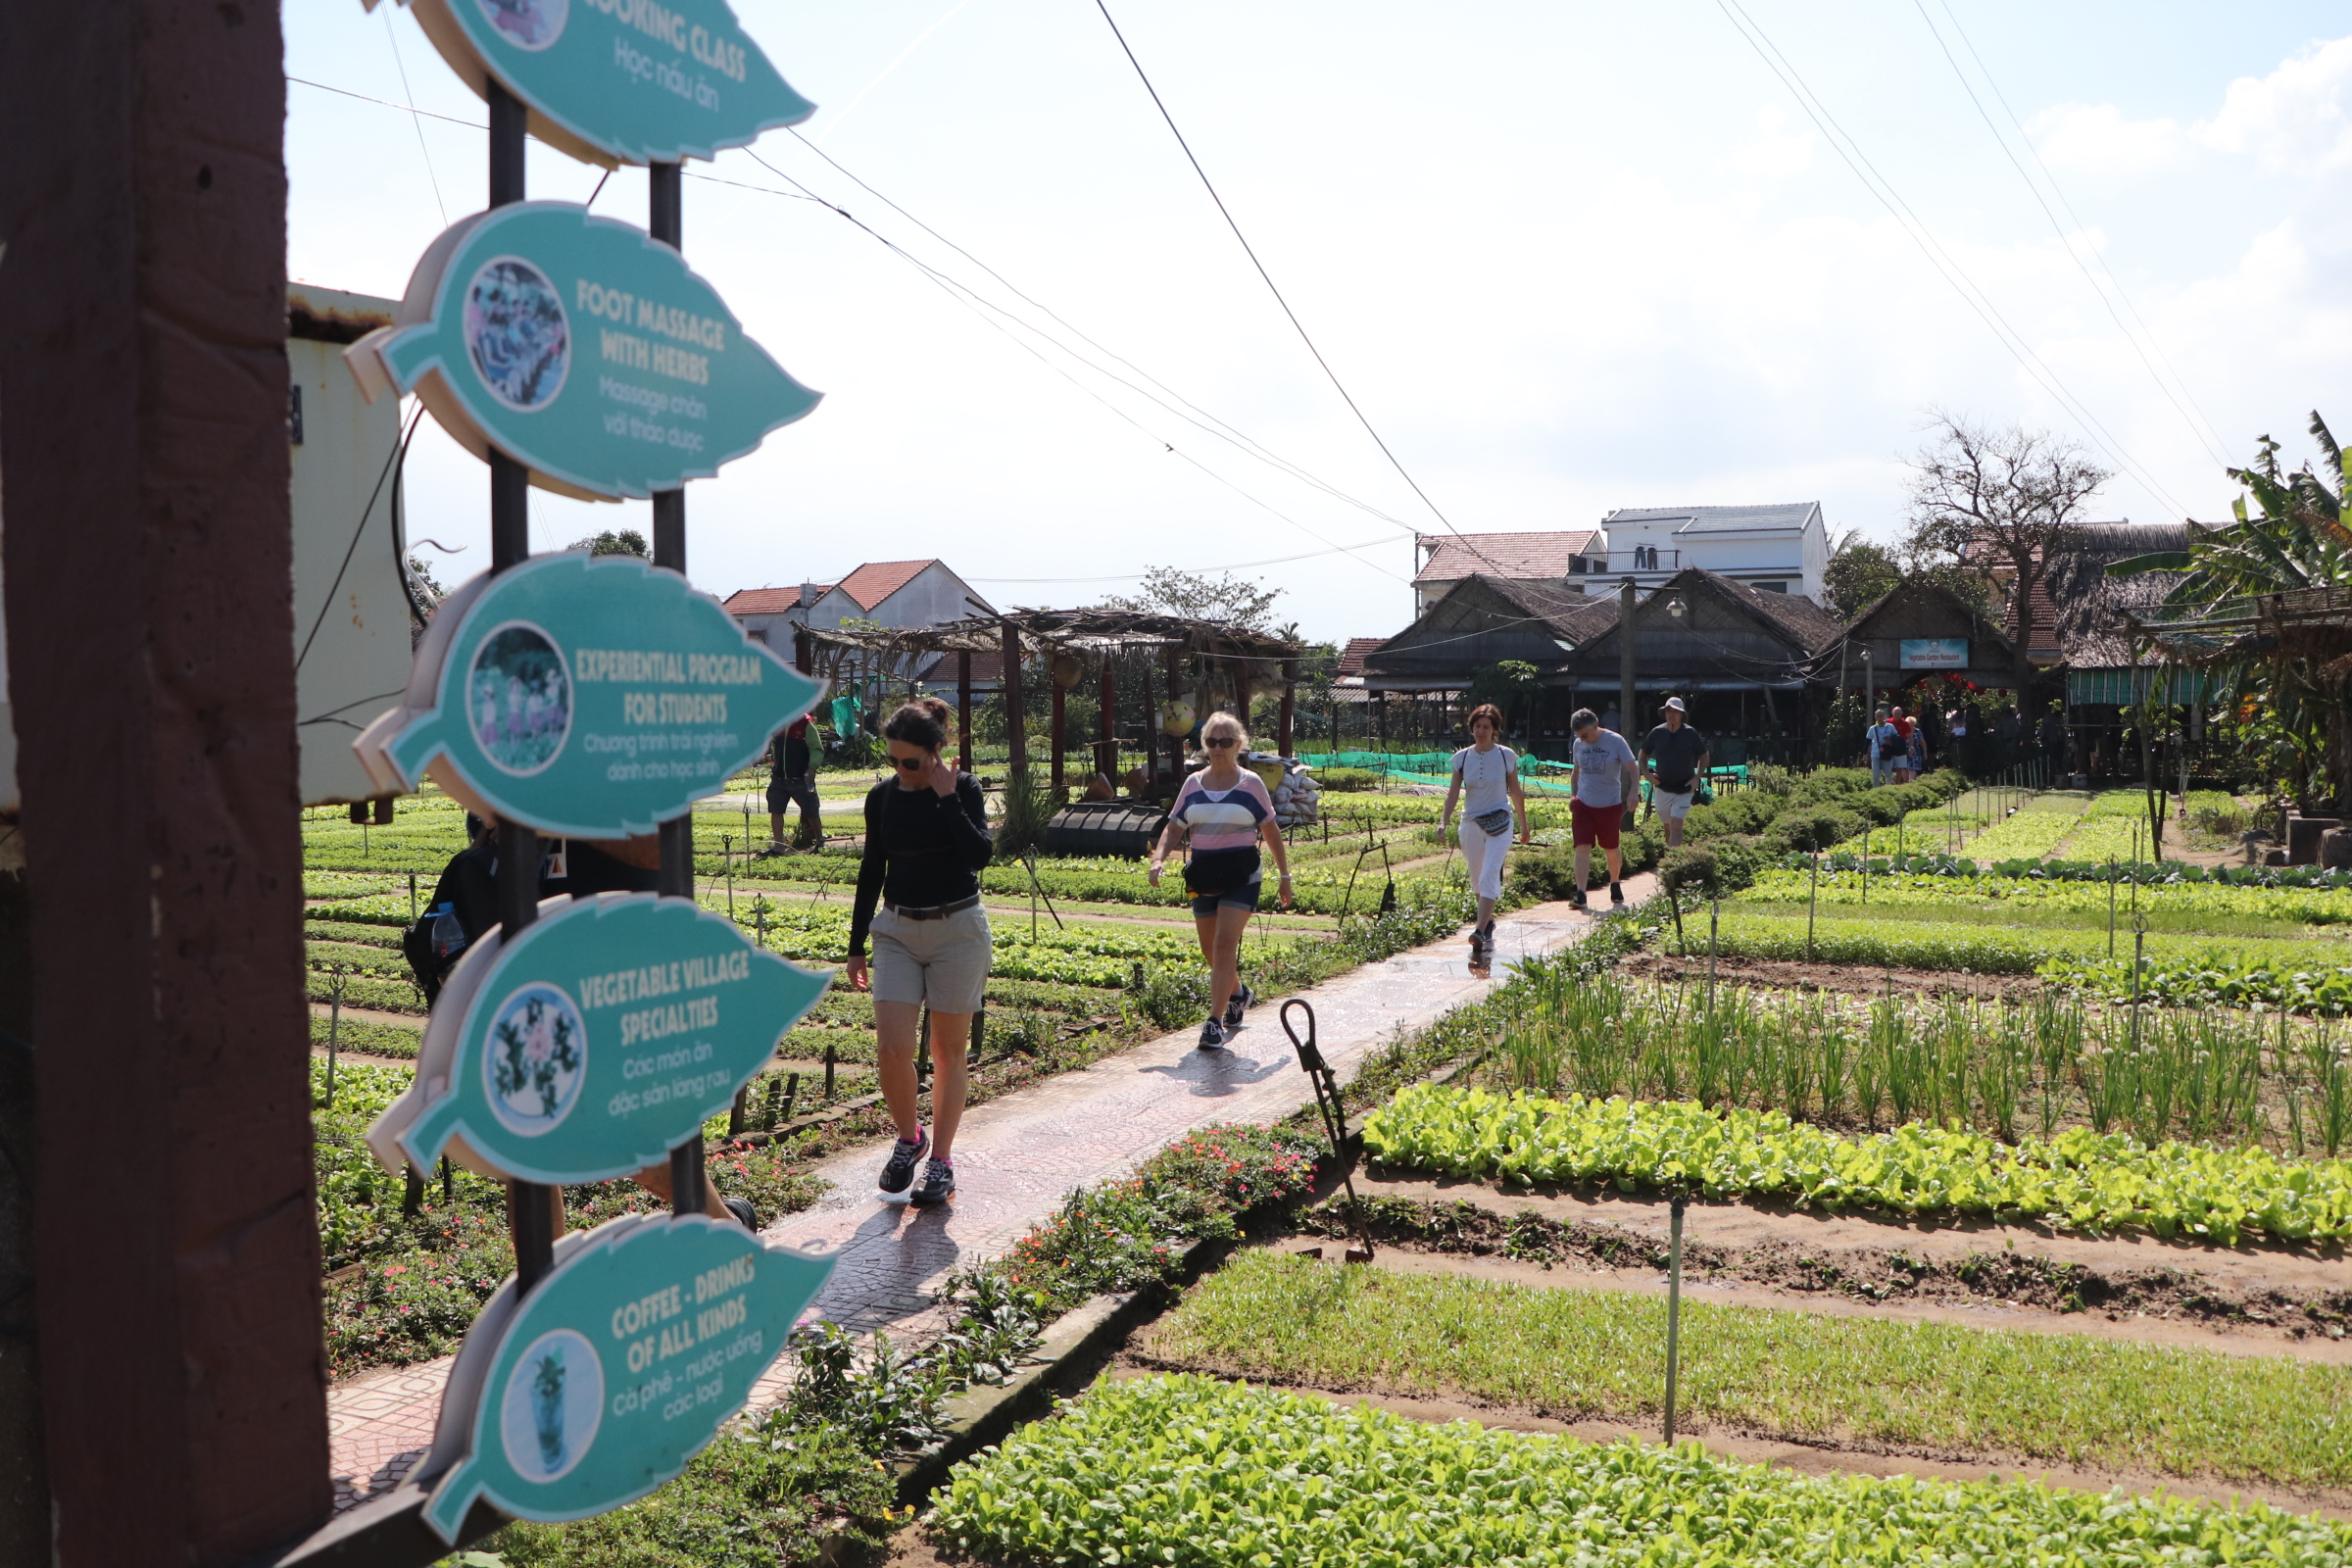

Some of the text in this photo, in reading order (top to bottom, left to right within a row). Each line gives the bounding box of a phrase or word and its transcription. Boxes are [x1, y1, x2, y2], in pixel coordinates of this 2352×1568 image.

[615, 36, 653, 83] Học
[657, 59, 692, 100] nấu
[691, 25, 746, 82] CLASS
[577, 279, 724, 351] FOOT MASSAGE
[601, 328, 709, 384] WITH HERBS
[600, 376, 667, 415] Massage
[577, 650, 761, 683] EXPERIENTIAL PROGRAM
[625, 693, 727, 723] FOR STUDENTS
[645, 760, 667, 779] cho
[671, 760, 693, 783] học
[697, 758, 719, 775] sinh
[580, 951, 750, 1009] VEGETABLE VILLAGE
[621, 996, 718, 1047] SPECIALTIES
[623, 1054, 654, 1080] Các
[658, 1046, 690, 1071] món
[610, 1091, 639, 1119] đặc
[708, 1067, 731, 1089] rau
[612, 1284, 682, 1340] COFFEE
[696, 1253, 755, 1304] DRINKS
[628, 1294, 746, 1373] OF ALL KINDS
[613, 1387, 637, 1416] Cà
[640, 1369, 673, 1410] phê
[687, 1348, 724, 1382] nước
[727, 1329, 762, 1361] uống
[664, 1373, 724, 1420] các loại
